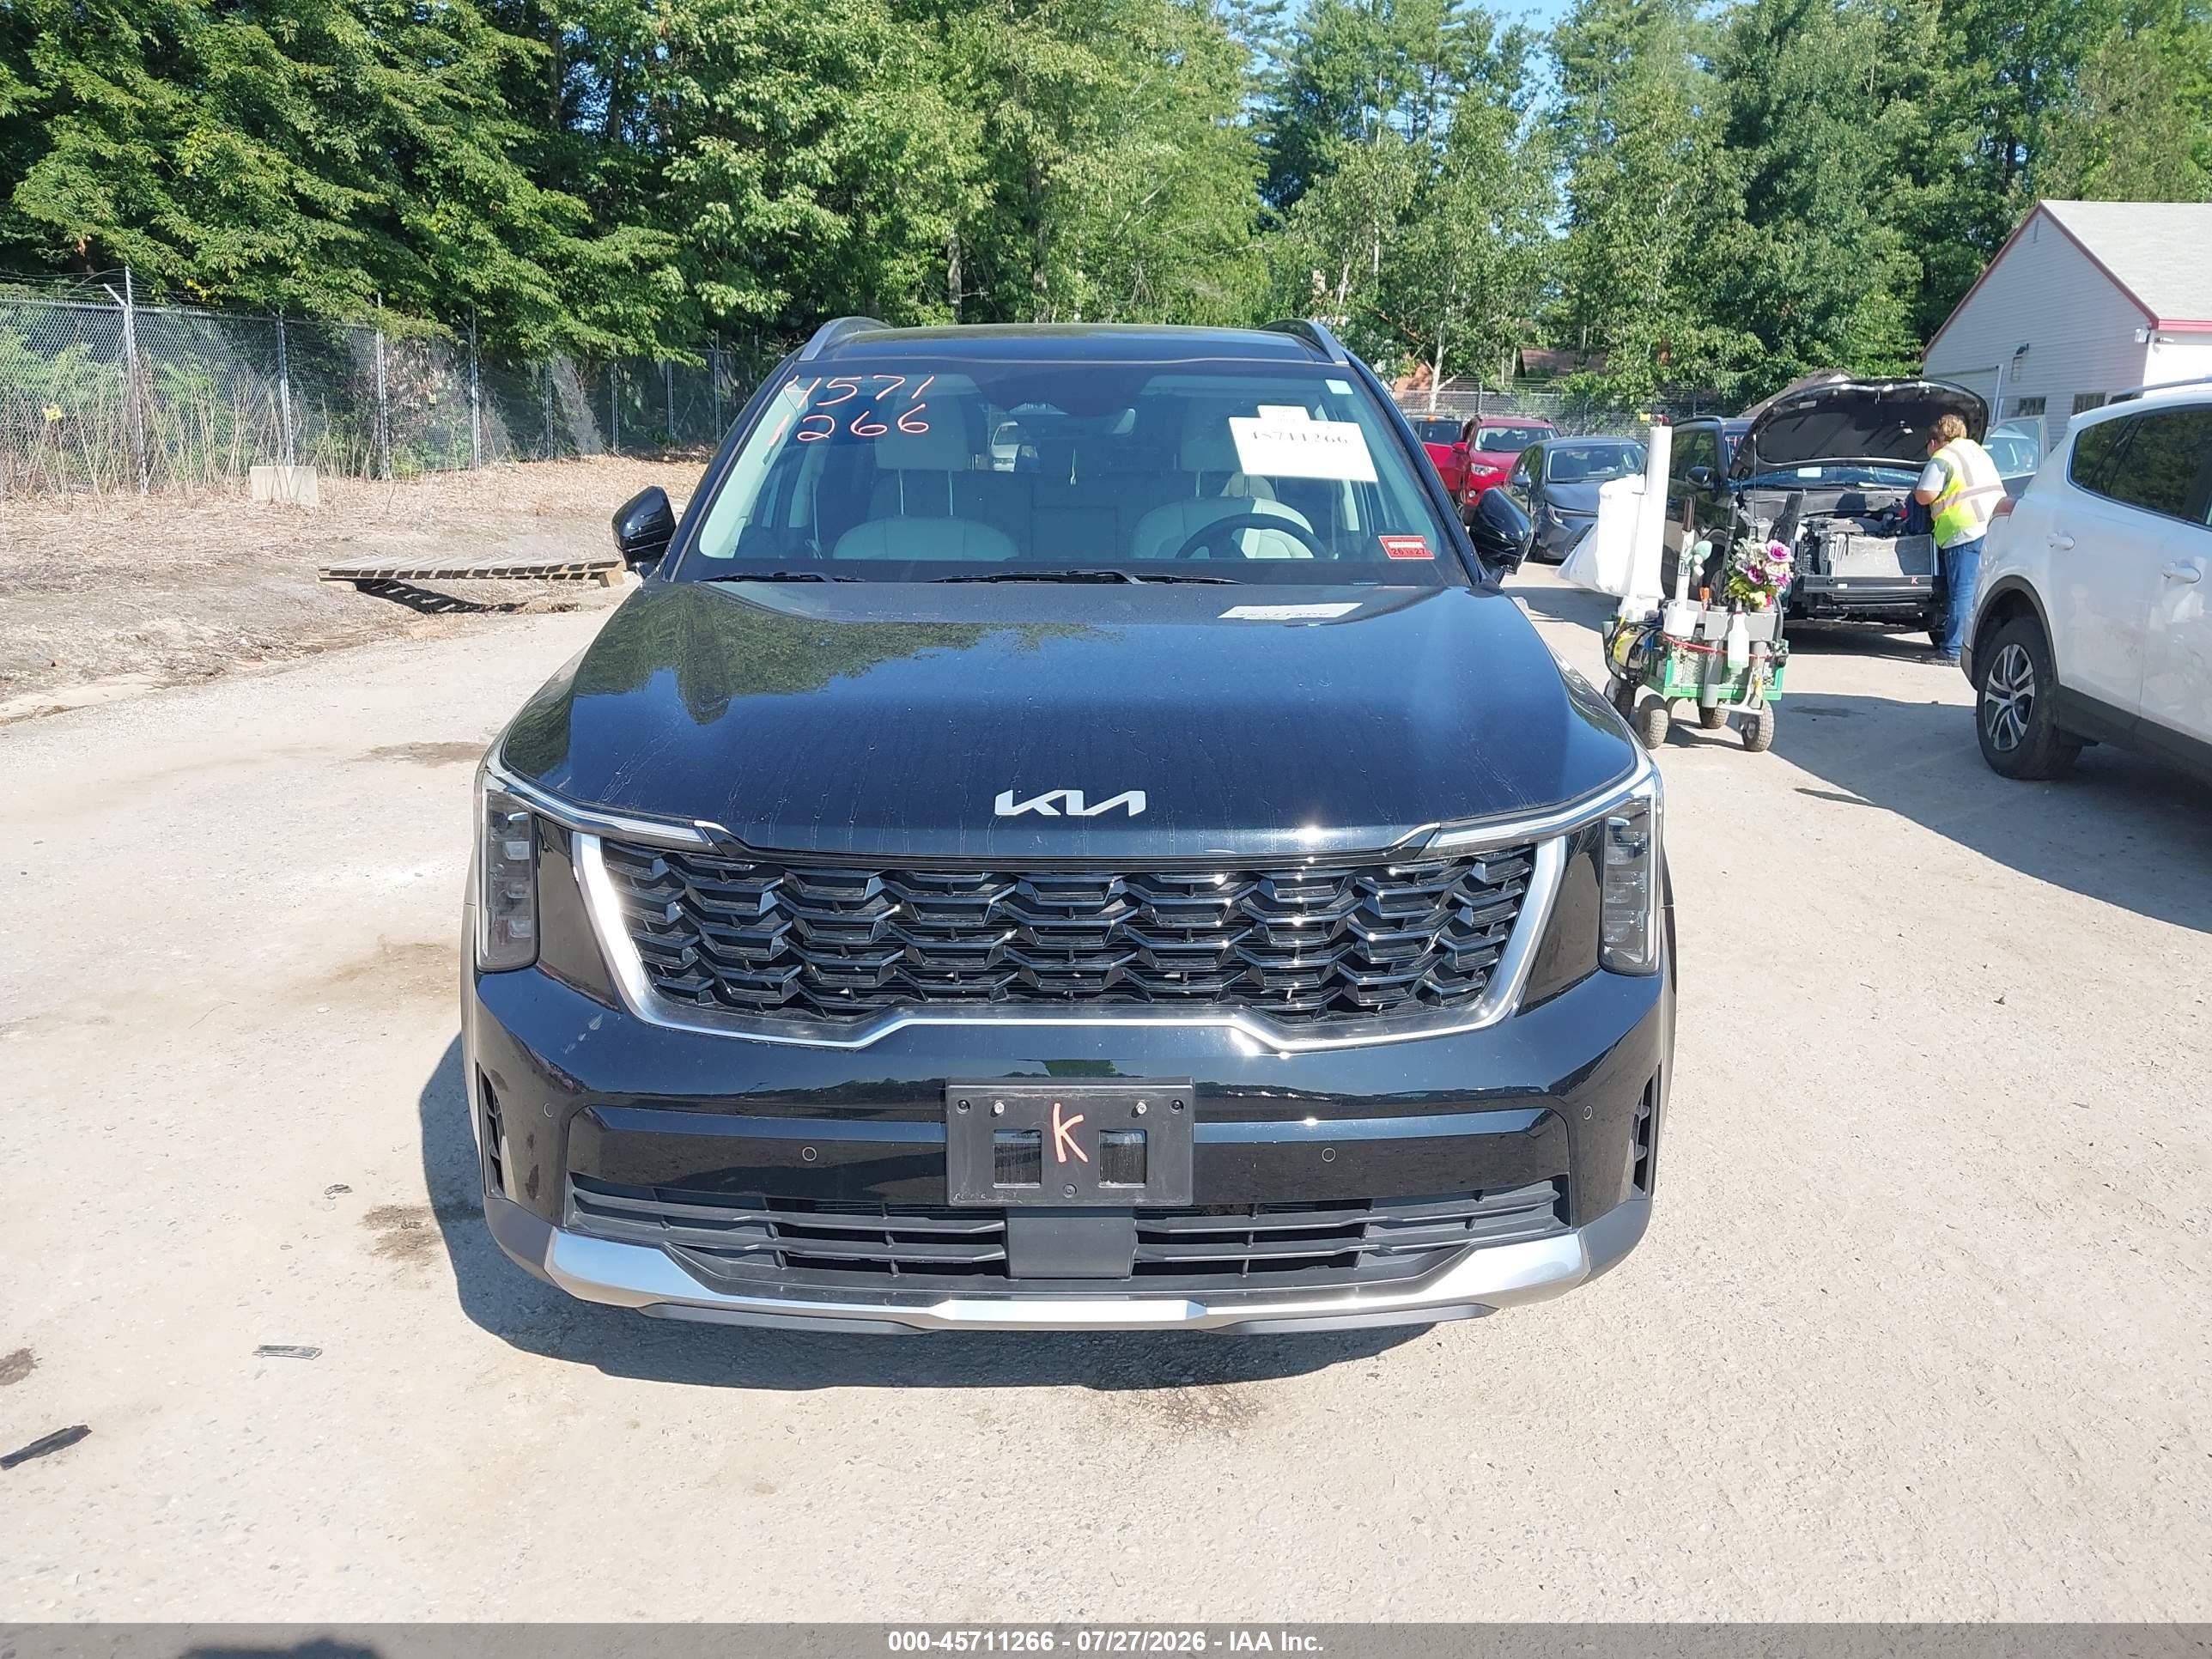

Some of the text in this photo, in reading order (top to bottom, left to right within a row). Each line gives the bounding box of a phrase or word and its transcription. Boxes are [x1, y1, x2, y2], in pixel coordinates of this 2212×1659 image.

[784, 374, 936, 410] 4571
[1414, 547, 1426, 556] 27
[994, 789, 1146, 817] KIA
